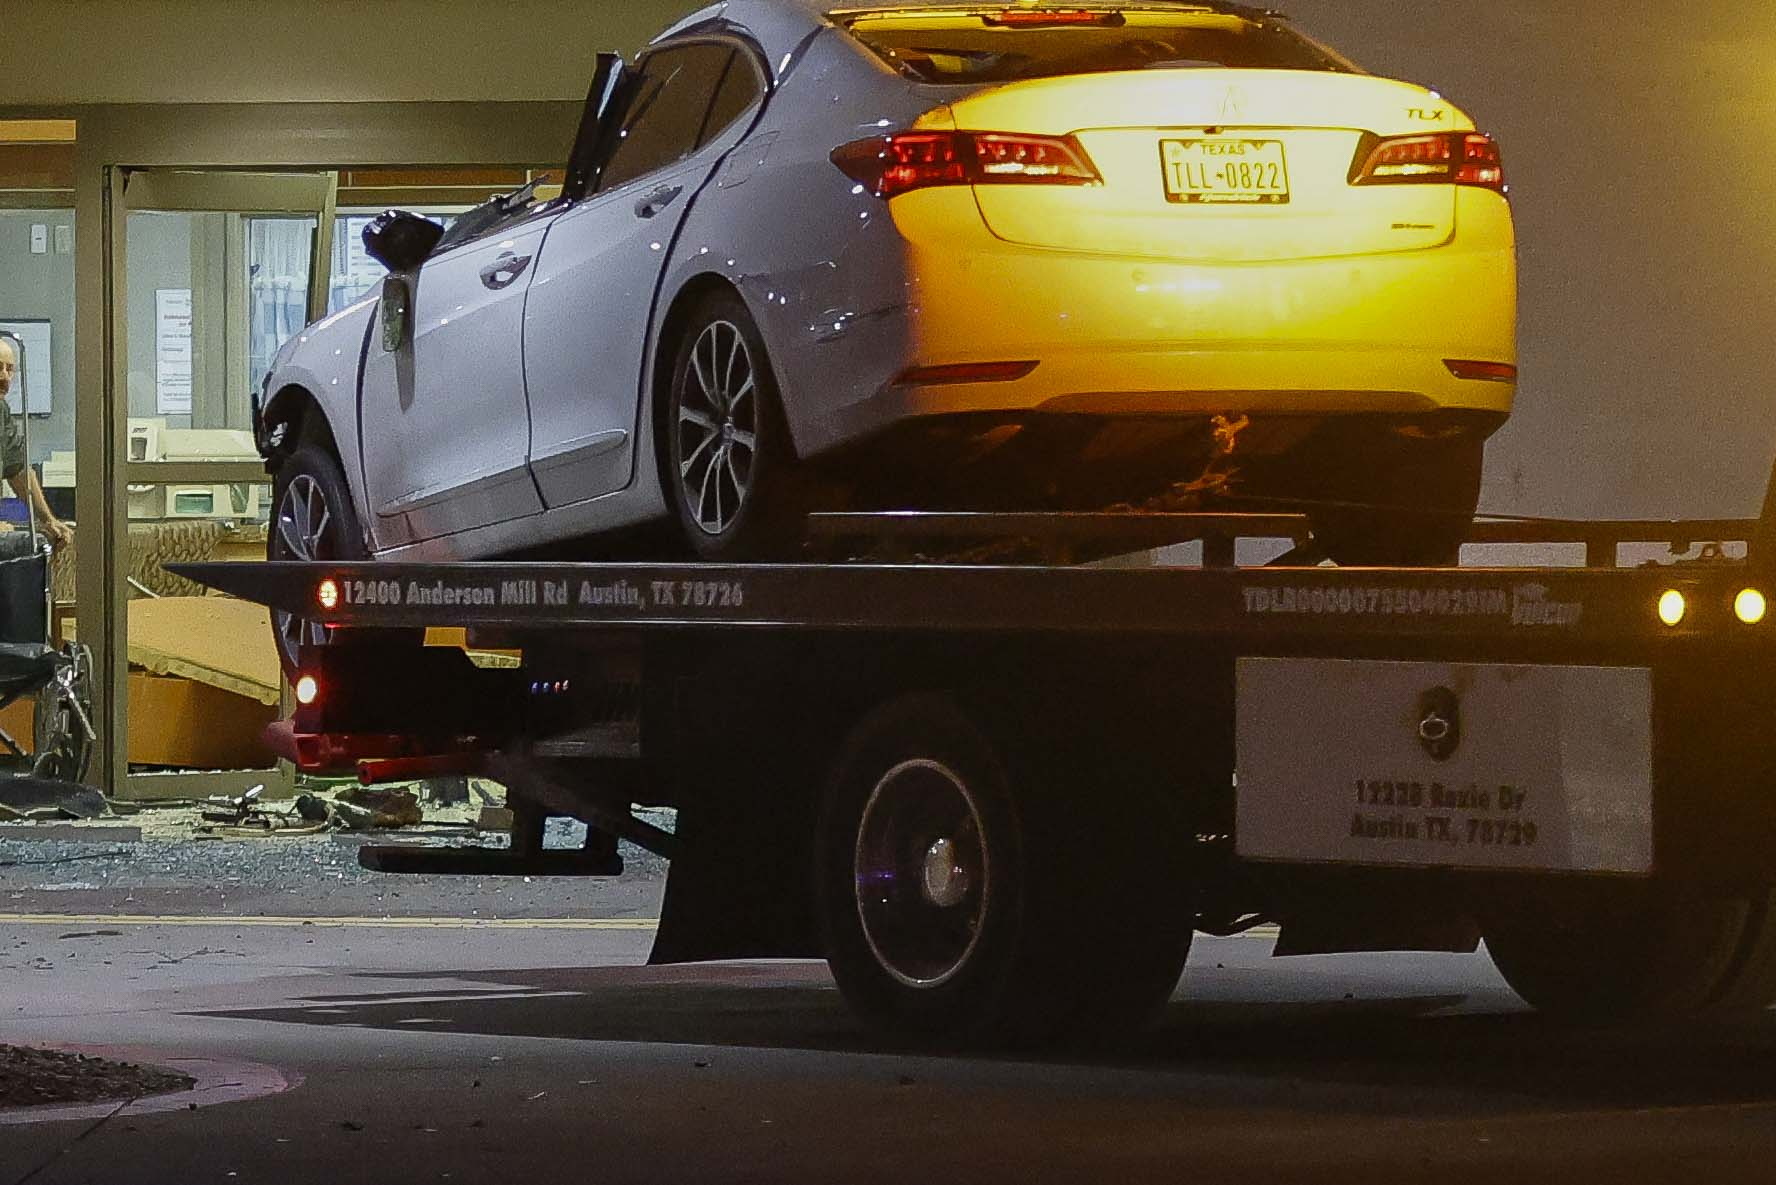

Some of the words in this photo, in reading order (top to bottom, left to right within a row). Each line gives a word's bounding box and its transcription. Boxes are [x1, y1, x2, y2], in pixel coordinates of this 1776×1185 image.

[1406, 108, 1443, 121] TLX
[1201, 143, 1245, 155] TEXAS
[344, 580, 400, 605] 12400
[406, 580, 495, 605] Anderson
[501, 580, 536, 605] Mill
[544, 580, 568, 605] Rd
[579, 580, 647, 610] Austin,
[651, 581, 675, 605] TX
[682, 581, 743, 605] 78726
[1499, 785, 1527, 810] Dr
[1350, 813, 1418, 839] Austin
